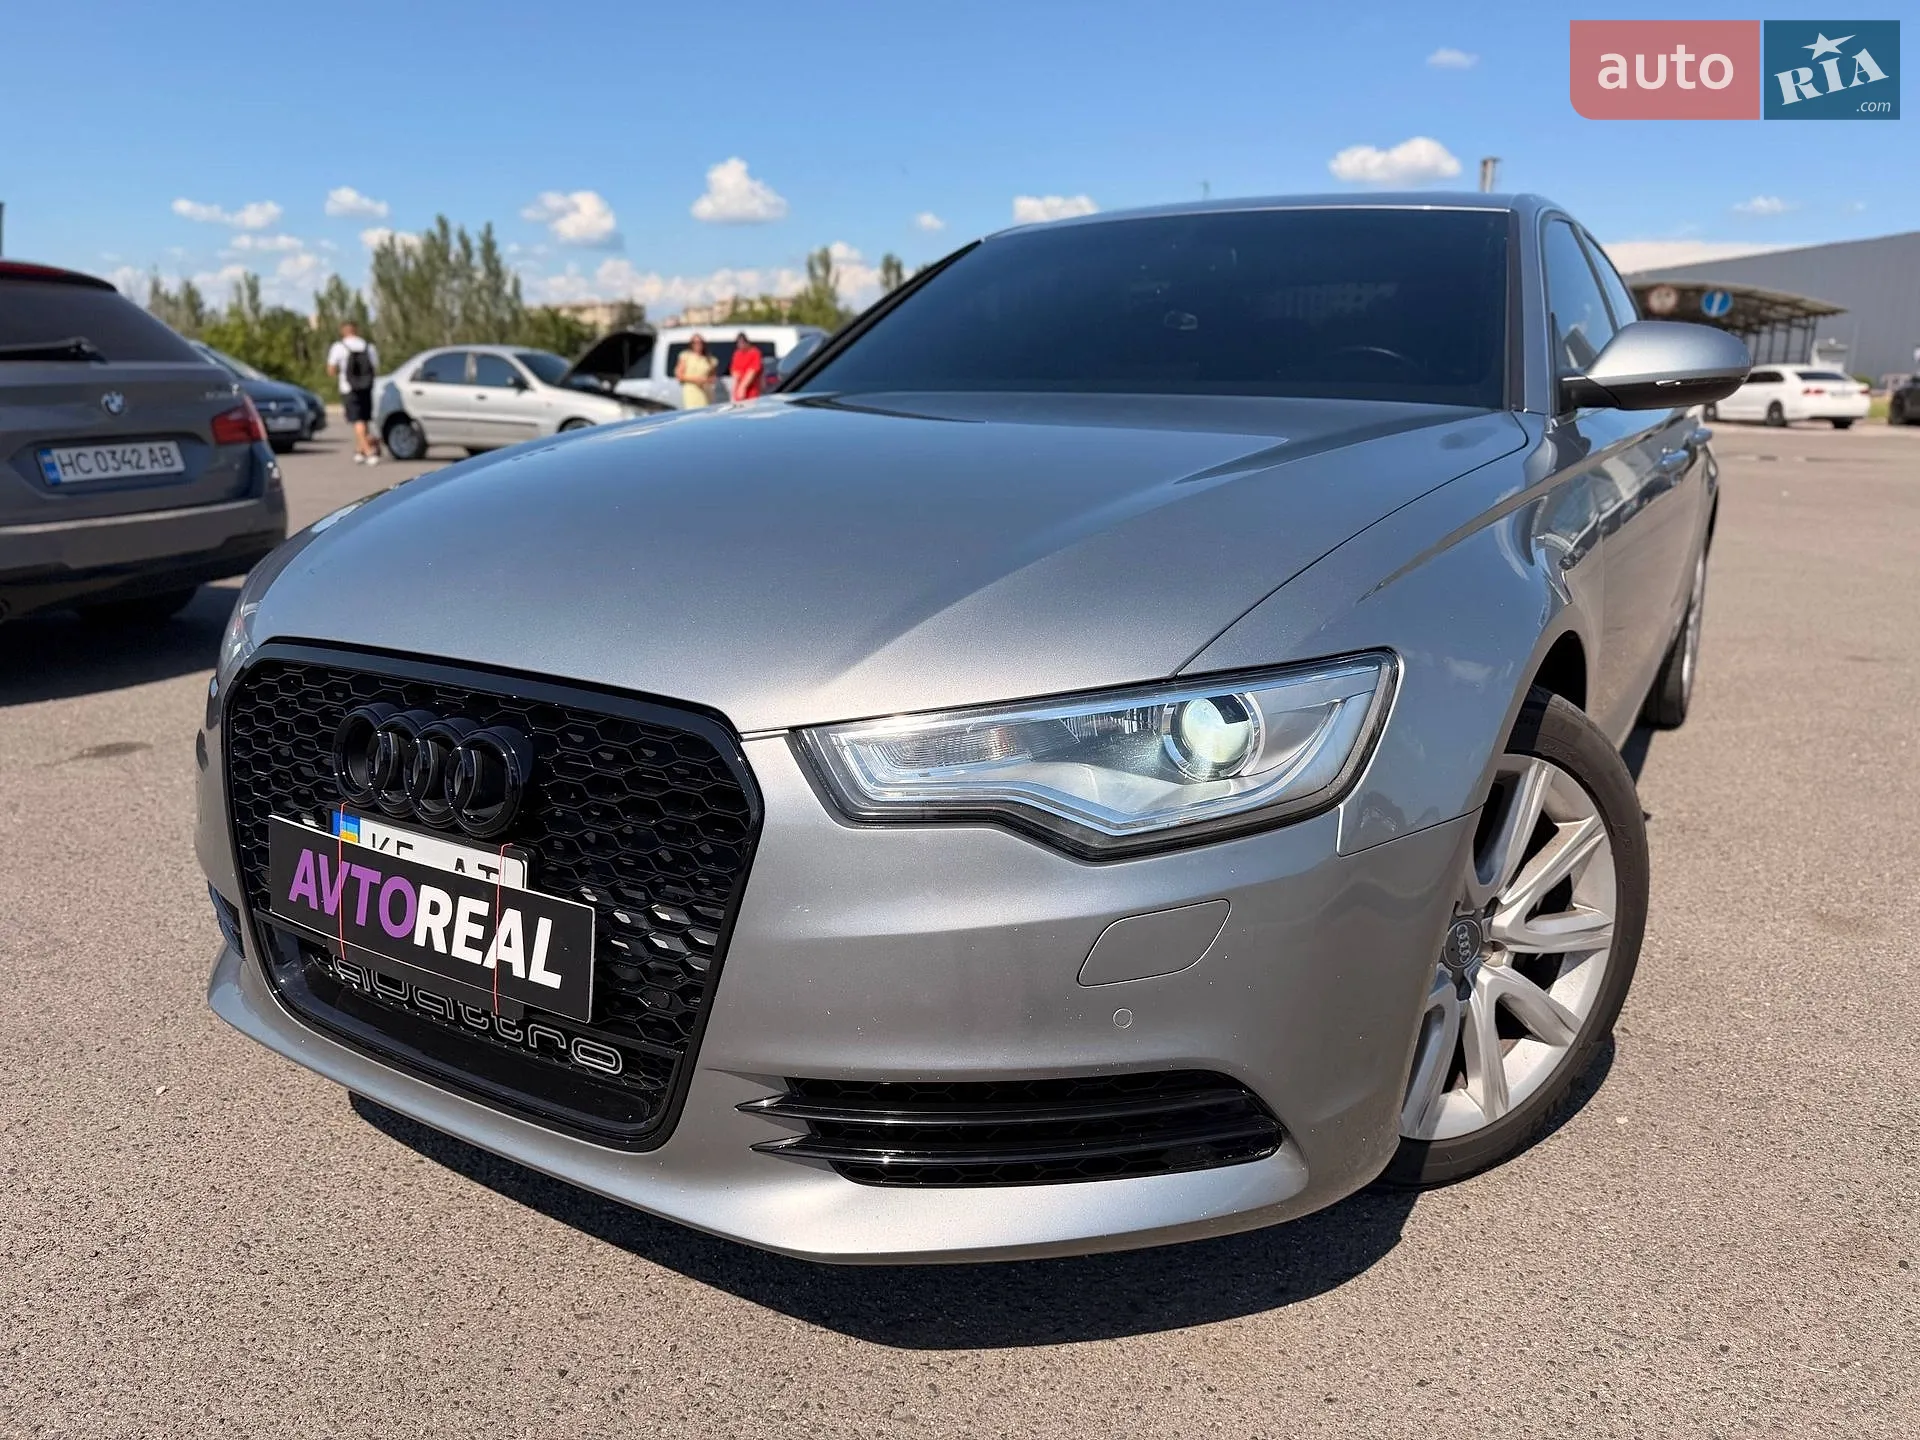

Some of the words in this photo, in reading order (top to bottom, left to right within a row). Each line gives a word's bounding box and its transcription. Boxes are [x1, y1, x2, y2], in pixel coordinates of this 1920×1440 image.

[57, 451, 93, 477] HC
[94, 448, 145, 473] 0342
[147, 446, 175, 469] AB
[288, 848, 562, 990] AVTOREAL
